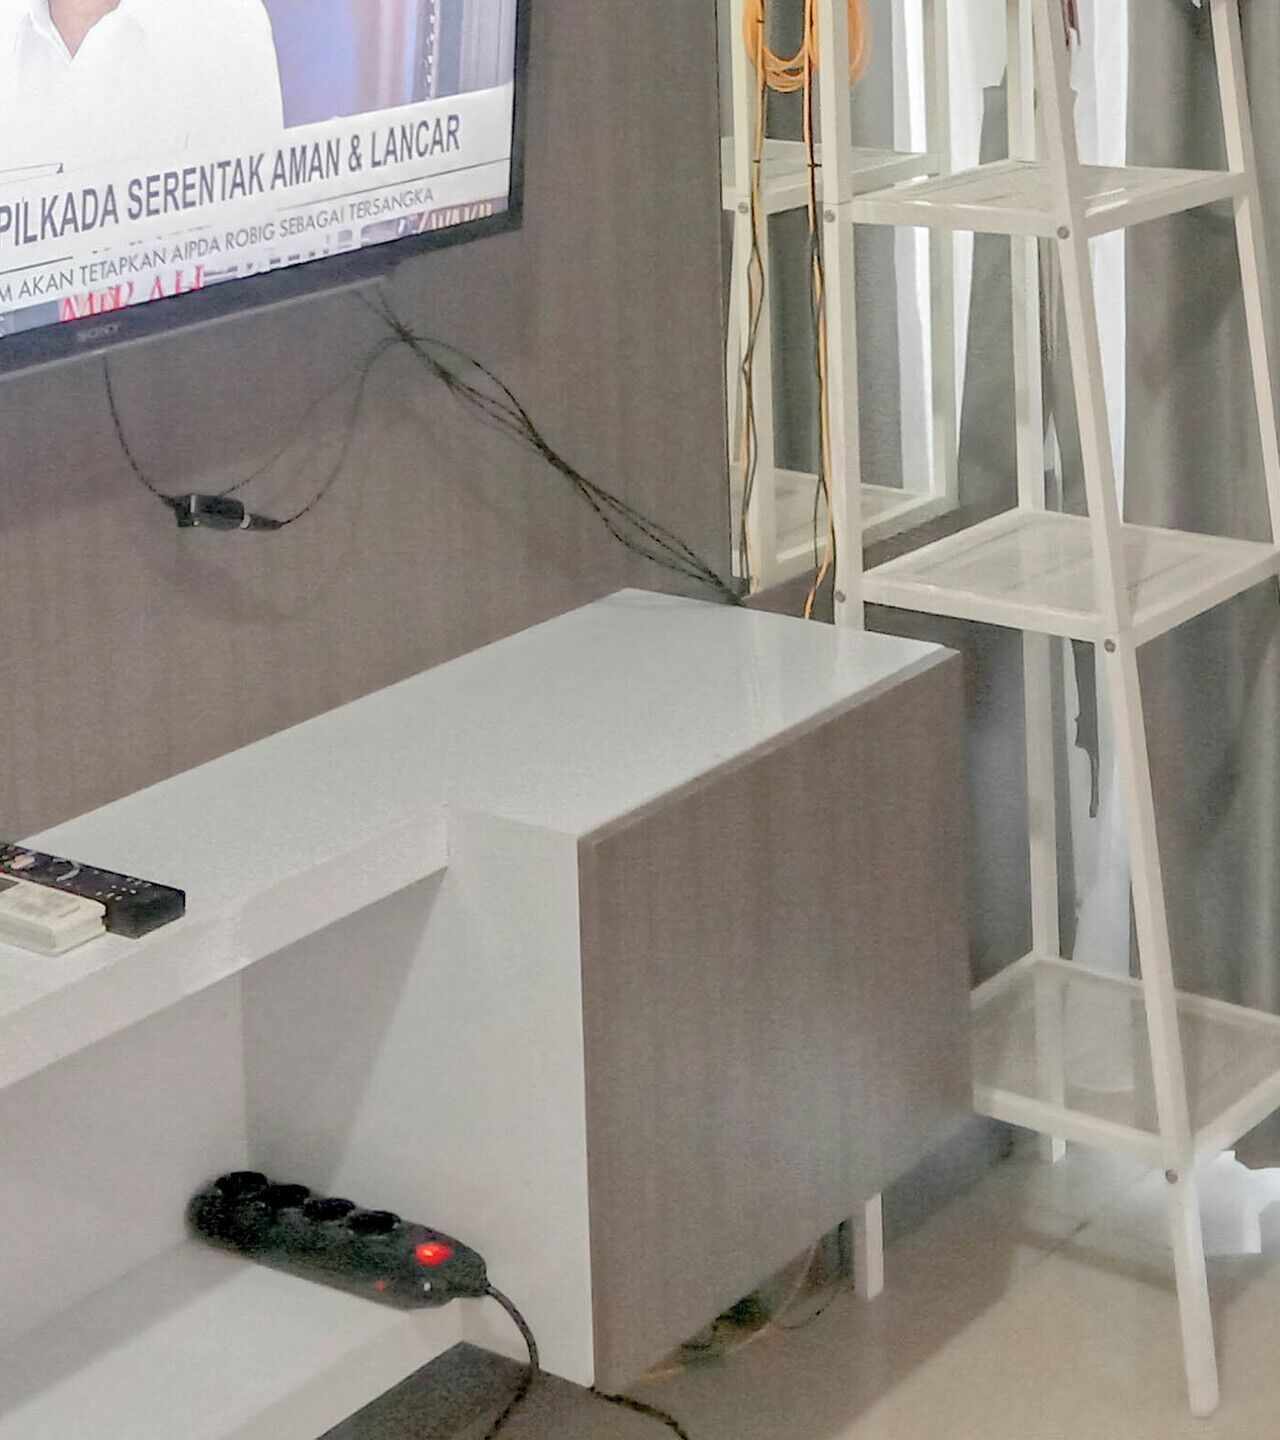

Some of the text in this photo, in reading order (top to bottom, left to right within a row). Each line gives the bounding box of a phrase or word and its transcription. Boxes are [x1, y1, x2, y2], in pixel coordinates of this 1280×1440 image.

[127, 153, 264, 220] SERENTAK
[270, 137, 341, 191] AMAN
[348, 134, 363, 172] &
[371, 114, 461, 169] LANCAR
[19, 268, 74, 299] AKAN
[80, 249, 166, 286] TETAPKAN
[170, 236, 220, 262] AIPDA
[225, 223, 275, 250] ROBIG
[280, 207, 345, 238] SEBAGAI
[349, 187, 435, 220] TERSANGKA
